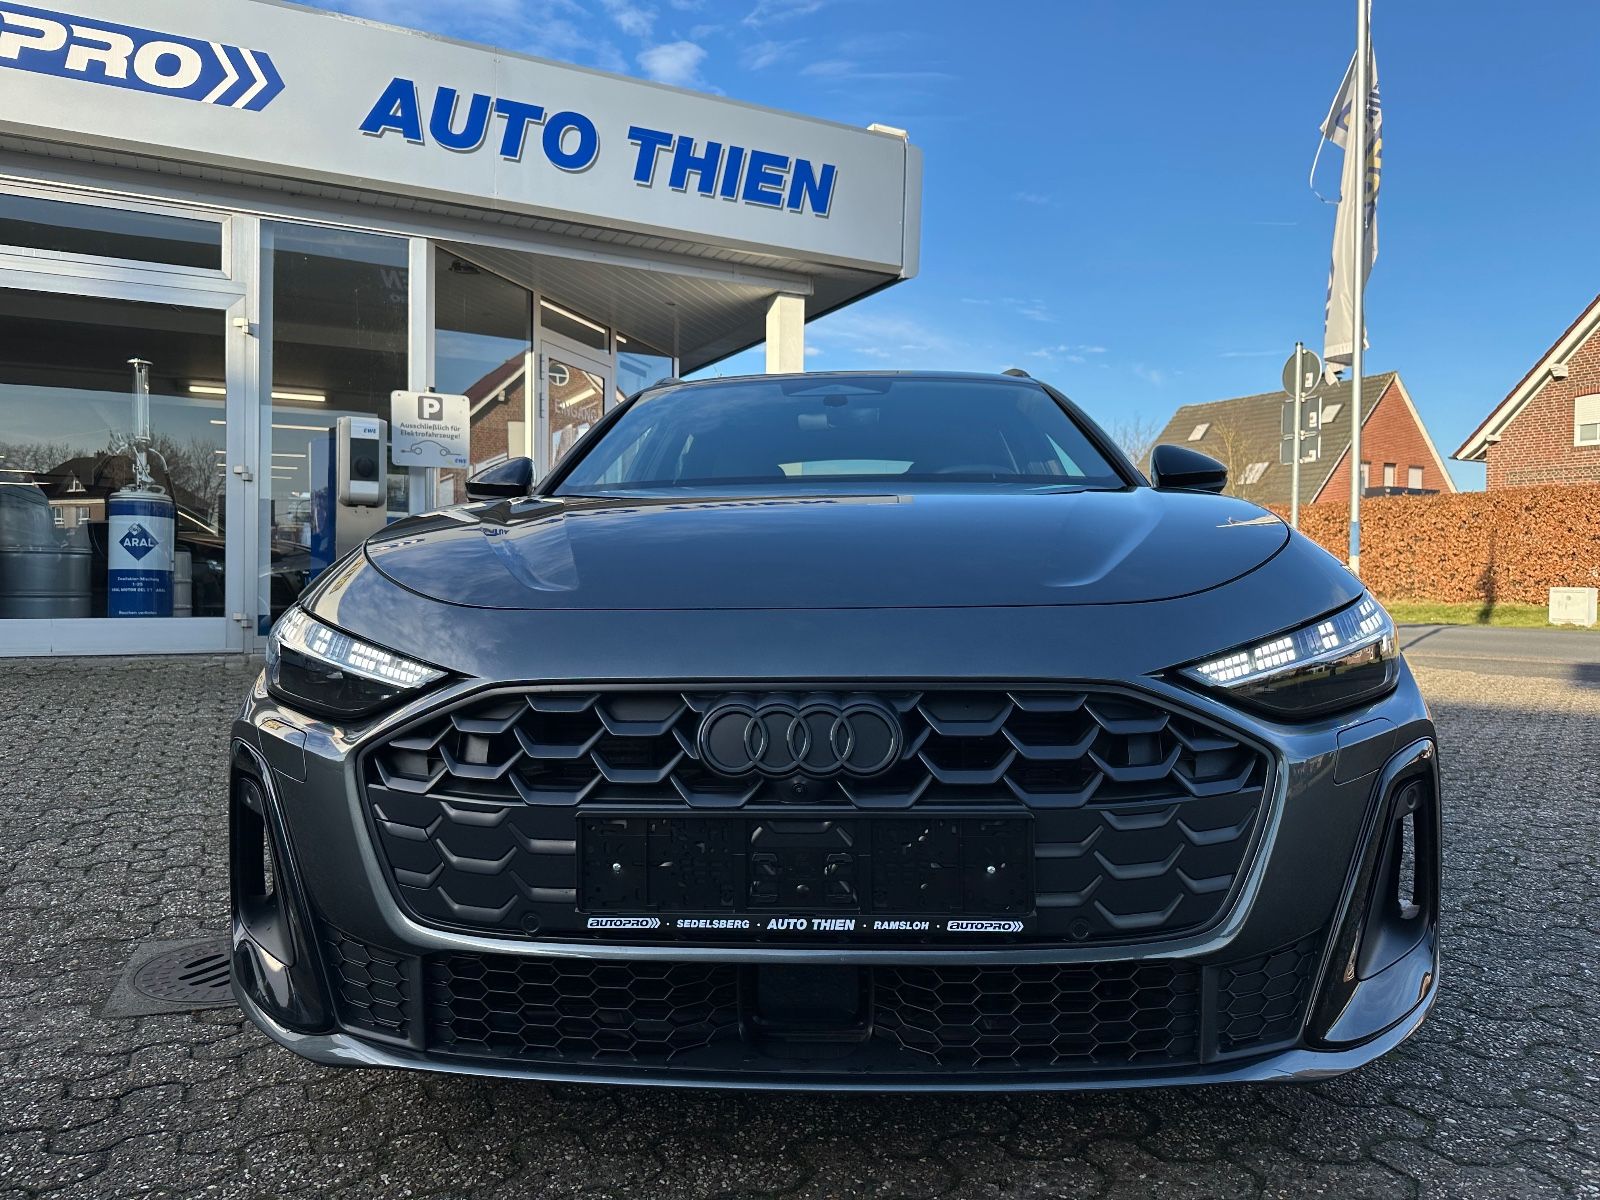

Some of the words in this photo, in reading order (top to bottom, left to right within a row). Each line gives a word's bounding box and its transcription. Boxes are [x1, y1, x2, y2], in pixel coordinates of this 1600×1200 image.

[359, 77, 599, 172] AUTO
[627, 125, 837, 217] THIEN
[423, 398, 441, 419] P
[400, 422, 450, 432] Ausschließlich
[400, 430, 461, 440] Elektrofahrzeuge!
[123, 538, 155, 547] ARAL
[676, 919, 750, 929] SEDELSBERG
[767, 918, 808, 931] AUTO
[812, 919, 856, 931] THIEN
[873, 920, 930, 930] RAMSLOH
